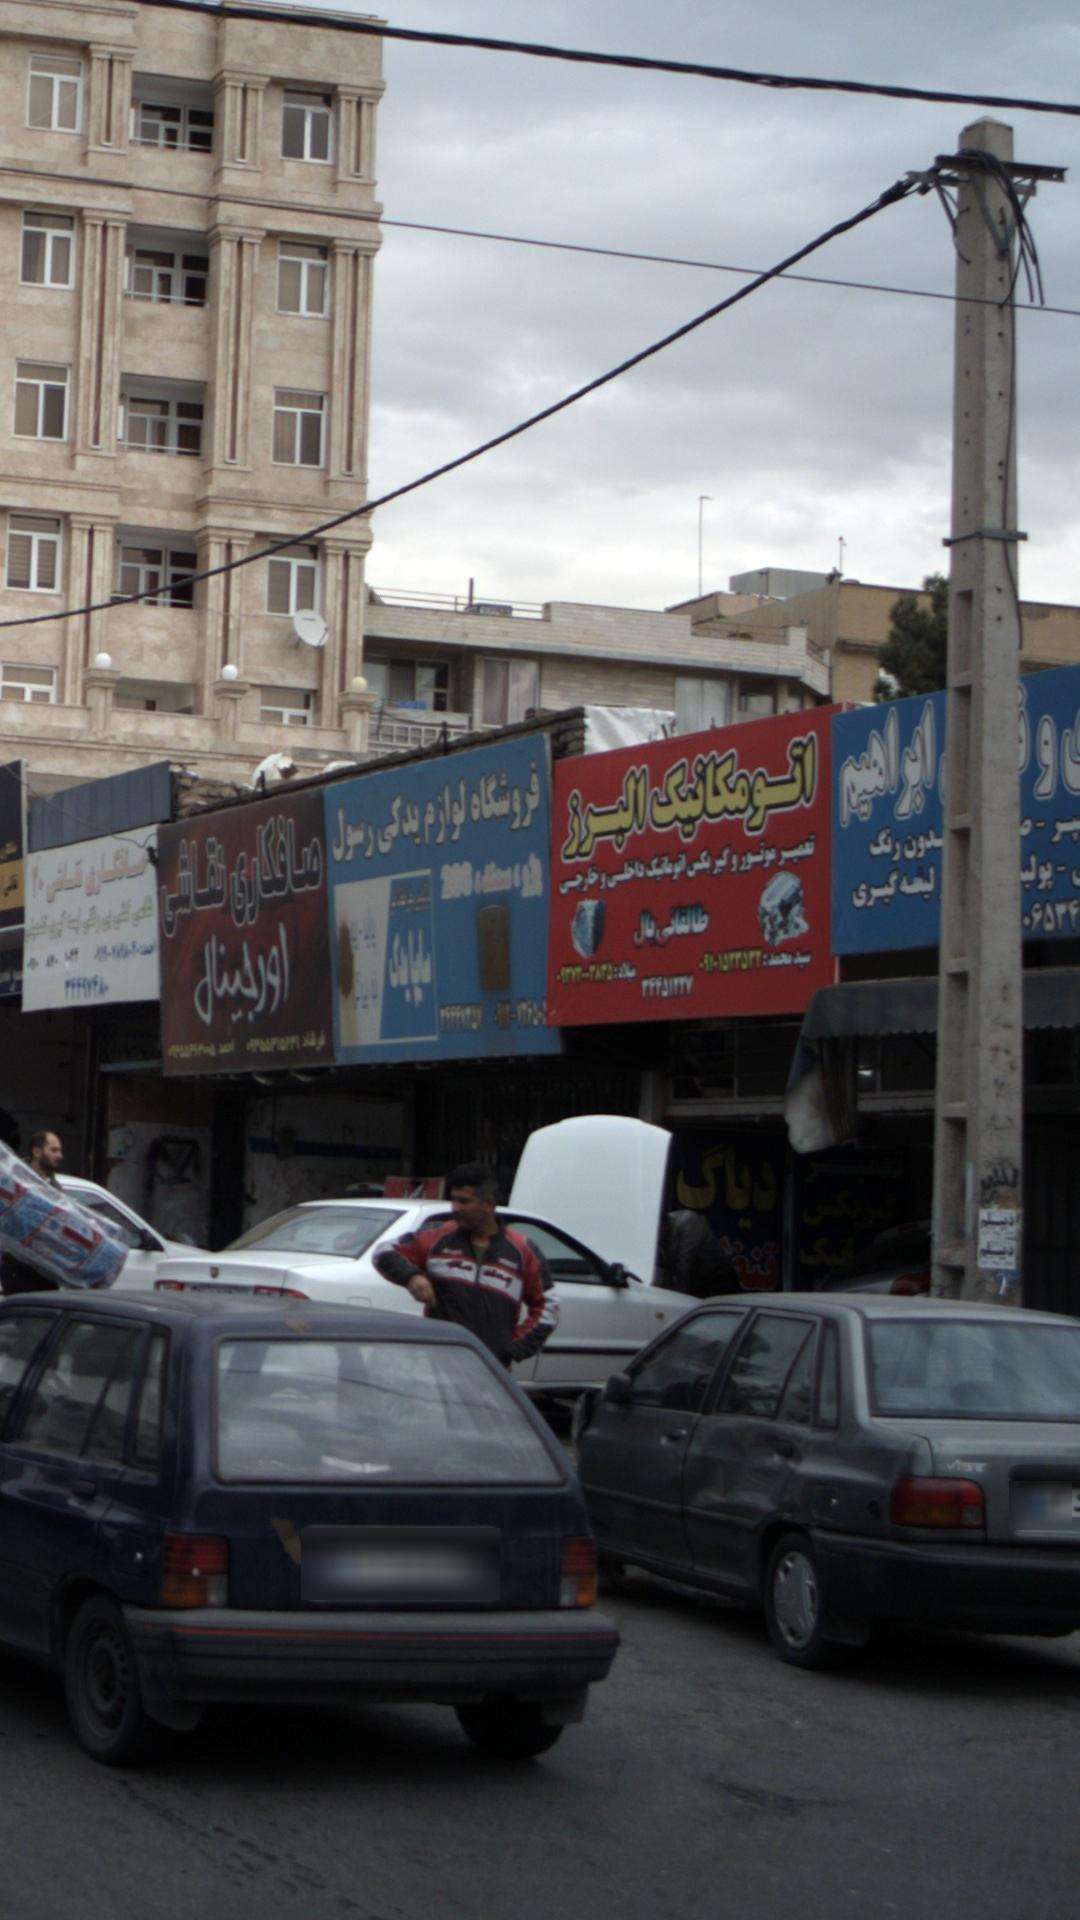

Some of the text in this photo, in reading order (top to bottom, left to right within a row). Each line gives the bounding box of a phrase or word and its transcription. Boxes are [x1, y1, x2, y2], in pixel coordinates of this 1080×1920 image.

[332, 761, 541, 861] فروشگاه لوازم یدکی رسول
[562, 764, 649, 863] البرز
[160, 837, 226, 938] نقاشی
[231, 814, 322, 927] صافکاری
[194, 922, 289, 1027] اورجینال
